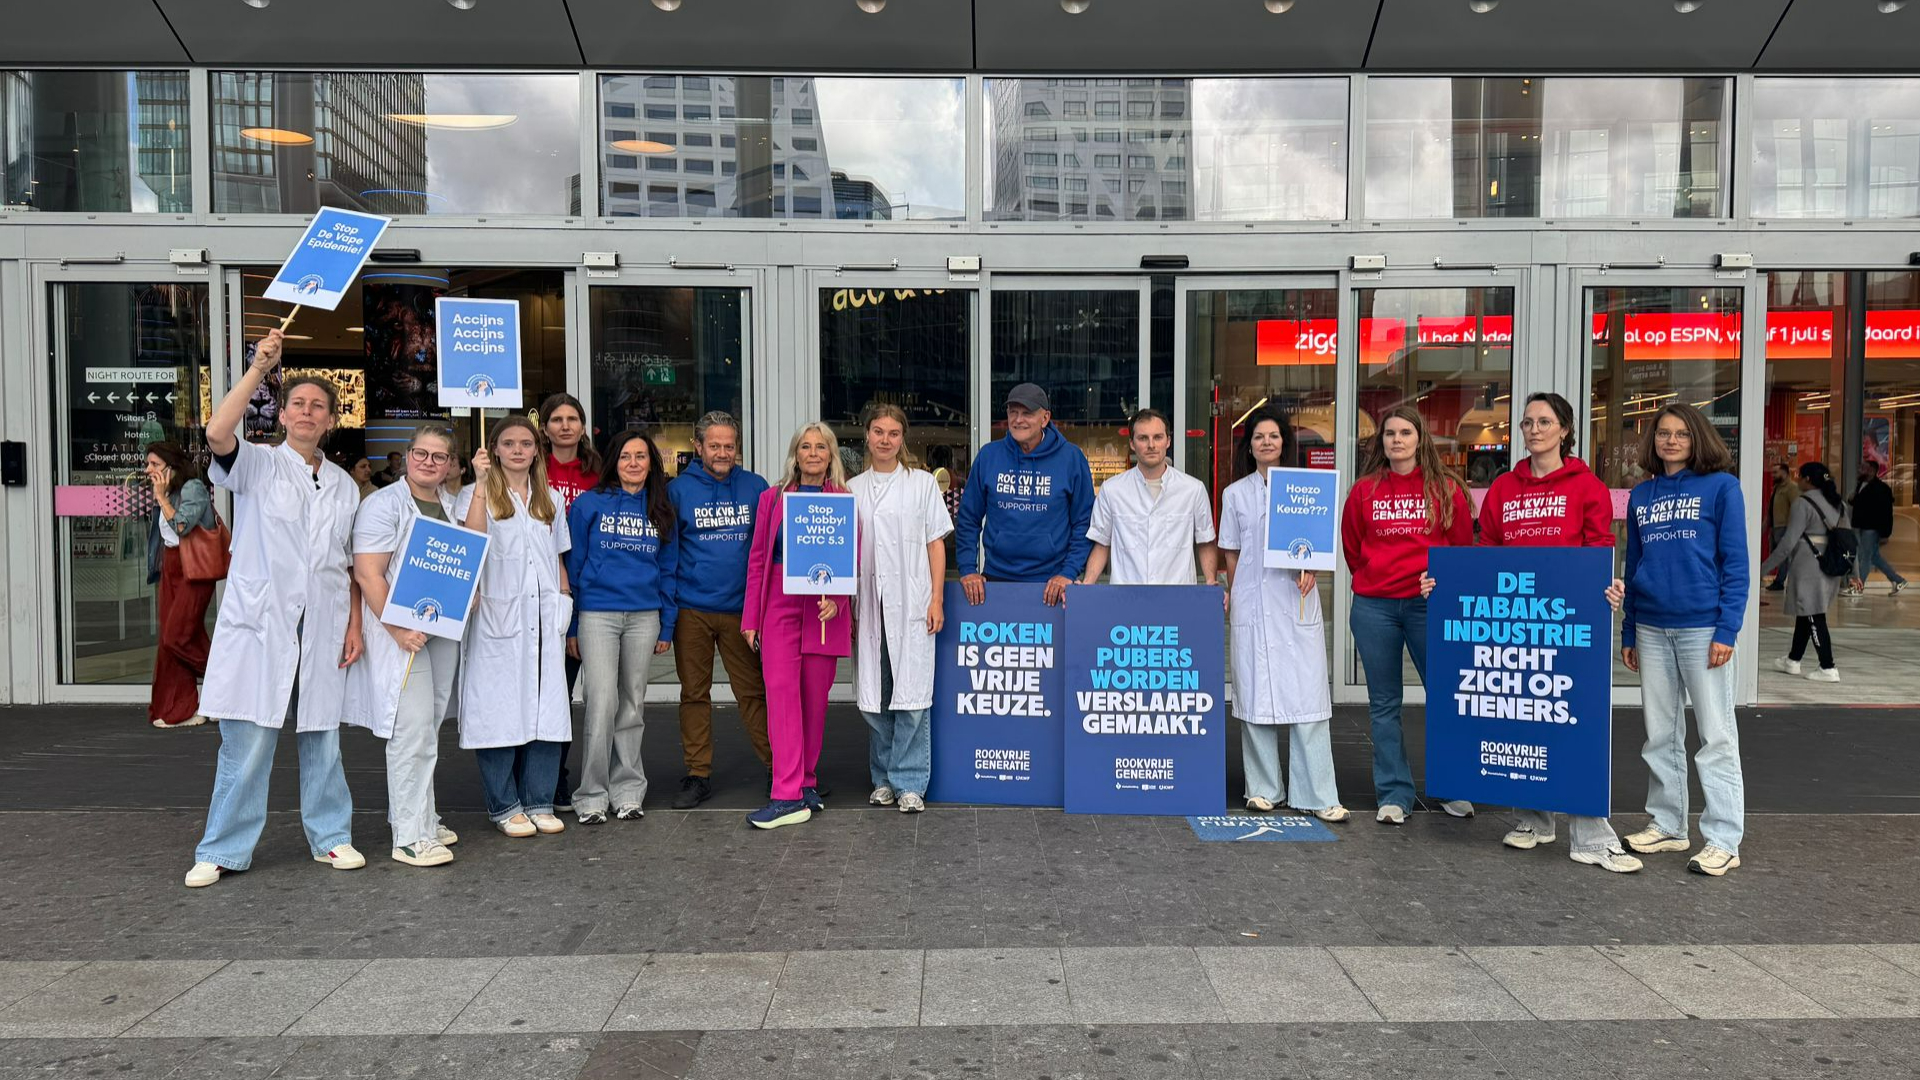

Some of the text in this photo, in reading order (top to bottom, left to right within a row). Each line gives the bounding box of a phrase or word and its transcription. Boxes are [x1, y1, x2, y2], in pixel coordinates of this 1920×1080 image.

[333, 222, 358, 235] Stop
[318, 229, 364, 245] De Vape
[307, 238, 363, 254] Epidemie!
[453, 314, 504, 327] Accijns
[453, 328, 504, 341] Accijns
[1644, 330, 1666, 346] op
[1670, 327, 1723, 344] ESPN,
[1780, 326, 1788, 341] 1
[1790, 326, 1818, 345] juli
[454, 341, 505, 354] Accijns
[87, 372, 174, 380] NIGHT ROUTE FOR
[116, 414, 145, 422] Visitors
[124, 431, 150, 439] Hotels
[88, 452, 118, 462] Closed:
[120, 453, 145, 461] 00:00
[1286, 484, 1321, 494] Hoezo
[997, 500, 1048, 512] SUPPORTER
[1290, 494, 1316, 506] Vrije
[808, 504, 834, 516] Stop
[1276, 504, 1328, 516] Keuze???
[1372, 509, 1427, 522] GENERATI
[1502, 506, 1566, 524] GENERATIE
[794, 514, 846, 526] de lobby!
[806, 525, 835, 534] WHO
[426, 536, 467, 556] Zeg JA
[796, 536, 844, 545] FCTC 5.3
[426, 548, 462, 566] tegen
[409, 556, 472, 581] NicotiNEE
[1498, 572, 1536, 594] DE
[1459, 596, 1576, 621] TABAKS-
[960, 622, 1053, 644] ROKEN
[1110, 625, 1178, 646] ONZE
[1444, 619, 1592, 648] INDUSTRIE
[958, 645, 1054, 668] IS GEEN
[1096, 648, 1192, 668] PUBERS
[1474, 645, 1558, 672] RICHT
[970, 670, 1040, 692] VRIJE
[1090, 670, 1199, 690] WORDEN
[1458, 670, 1573, 698] ZICH OP
[957, 693, 1052, 717] KEUZE.
[1076, 692, 1214, 712] VERSLAAFD
[1454, 693, 1578, 725] TIENERS.
[1082, 714, 1207, 735] GEMAAKT.
[975, 749, 1030, 760] ROOKVRIJE
[1480, 740, 1548, 758] ROOKVRIJE
[975, 760, 1030, 770] GENERATIE
[1115, 758, 1174, 769] ROOKVRIJE
[1480, 753, 1548, 770] GENERATIE
[1115, 769, 1174, 780] GENERATIE
